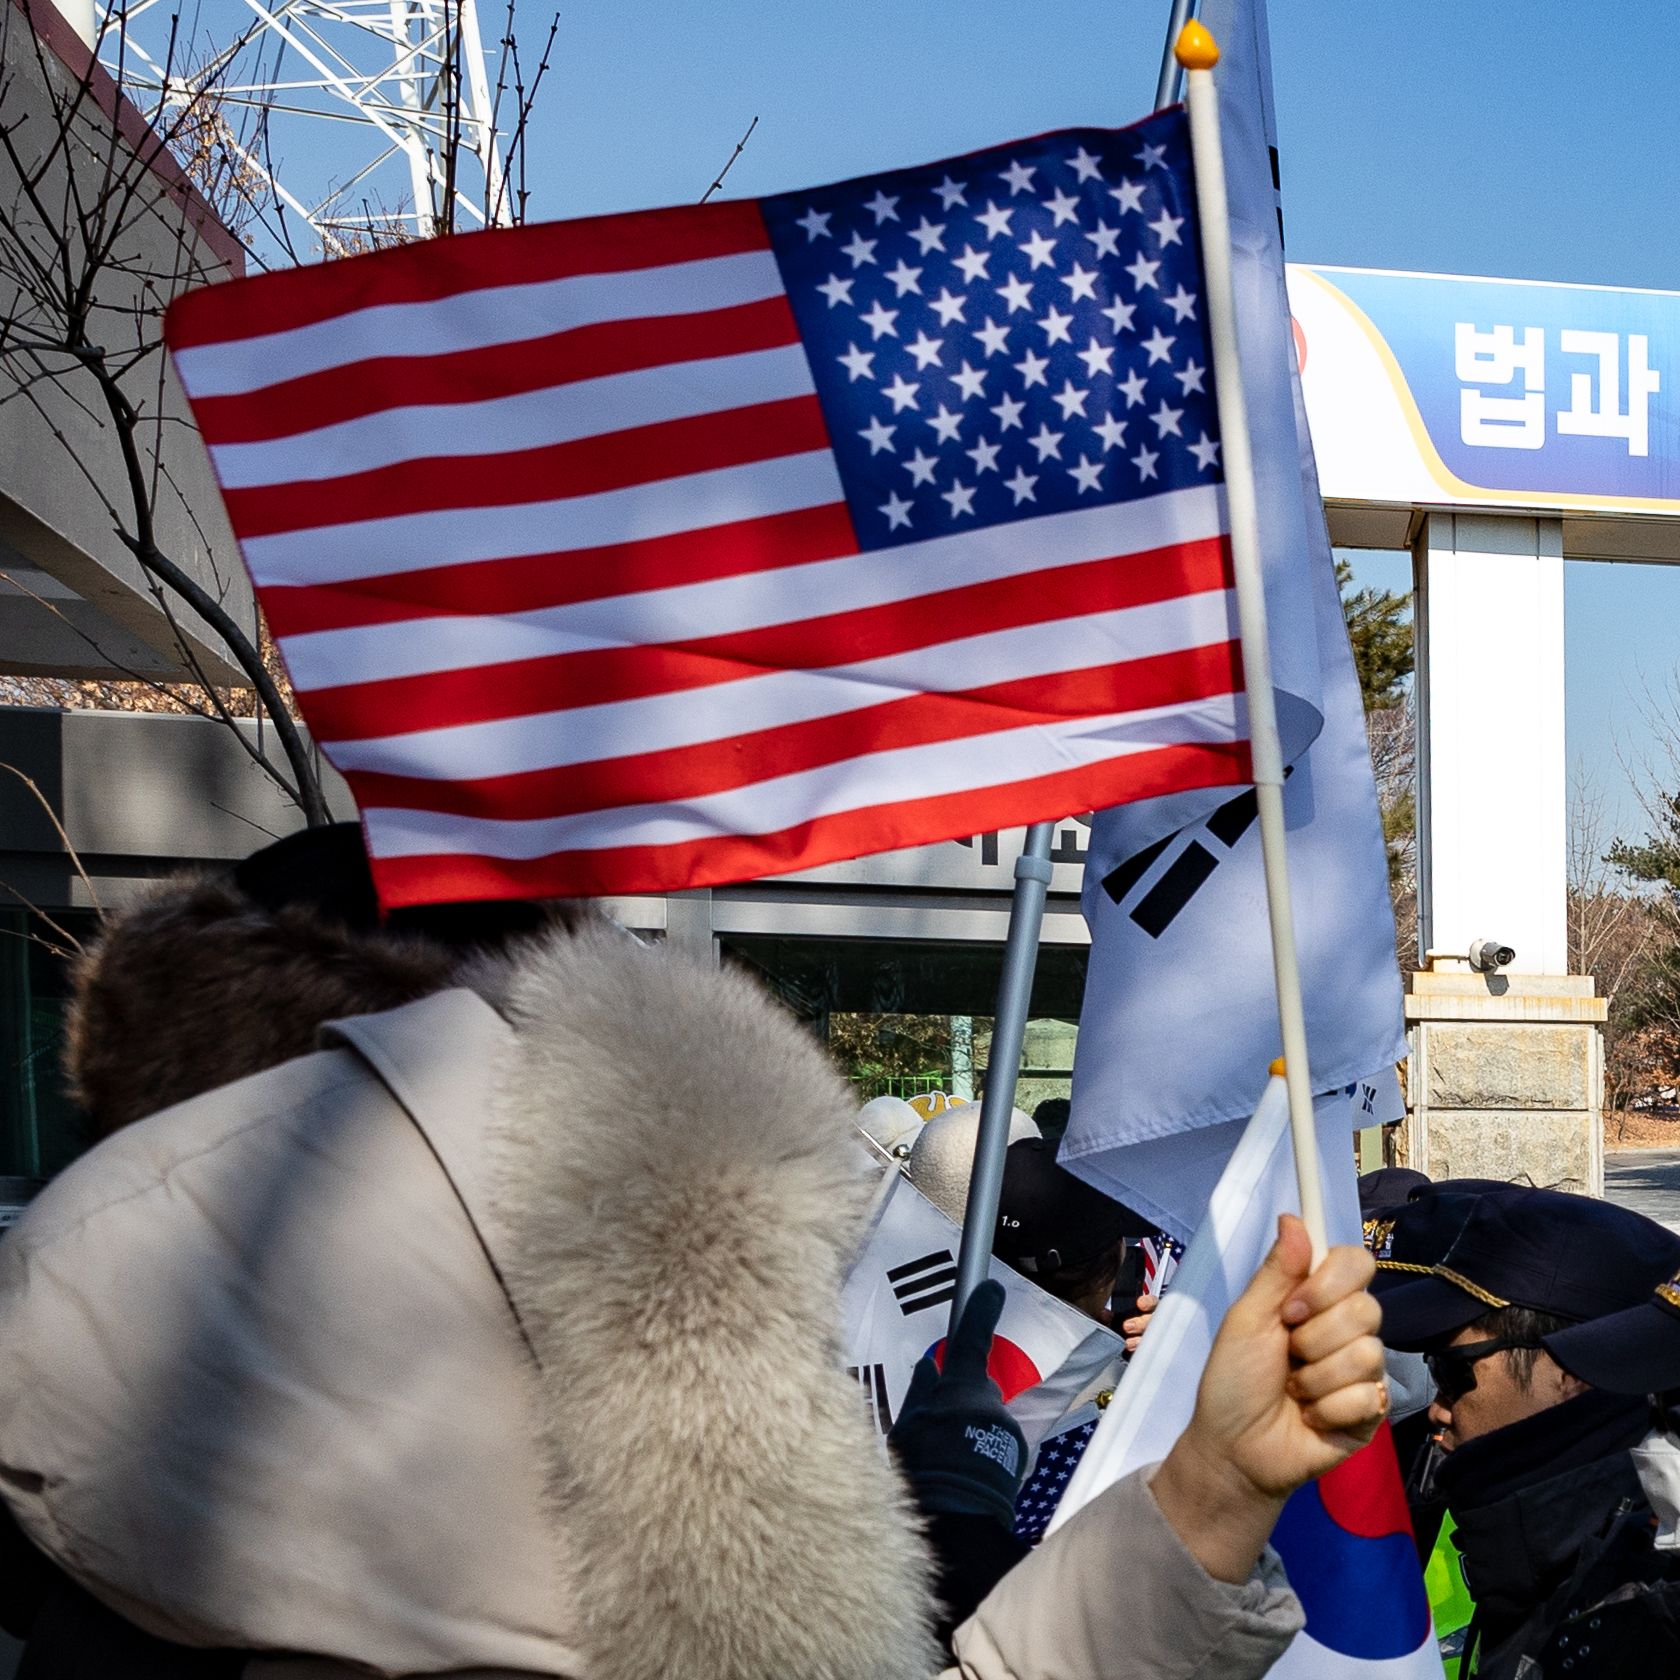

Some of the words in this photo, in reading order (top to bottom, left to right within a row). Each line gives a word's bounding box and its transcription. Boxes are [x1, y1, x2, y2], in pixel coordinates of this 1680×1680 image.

[1454, 322, 1660, 457] 법과
[965, 1425, 1008, 1450] NORTH
[974, 1441, 1005, 1464] FACE
